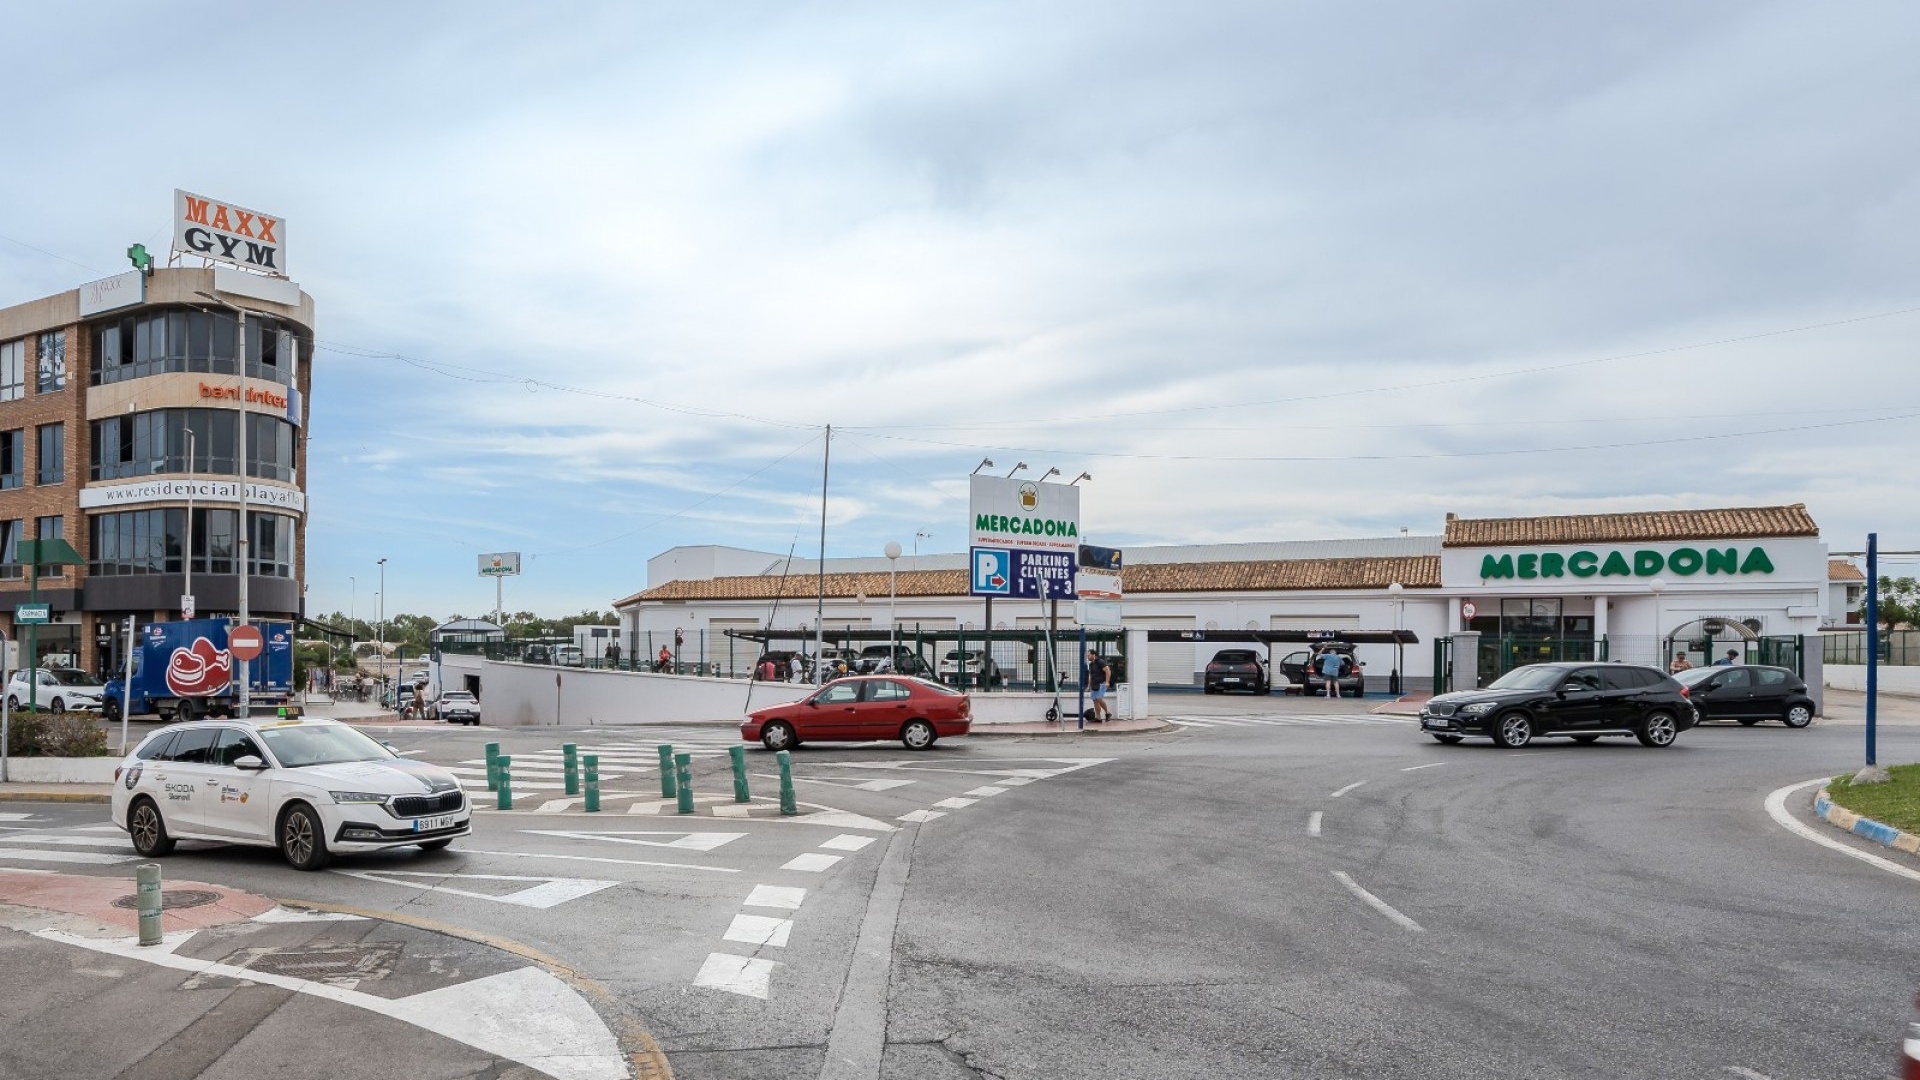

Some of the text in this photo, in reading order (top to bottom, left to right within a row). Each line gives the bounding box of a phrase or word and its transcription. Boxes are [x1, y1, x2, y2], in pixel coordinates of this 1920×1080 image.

[184, 195, 277, 243] MAXX
[184, 227, 277, 269] GYM
[975, 513, 1078, 538] MERCADONA
[978, 554, 998, 586] P
[1021, 553, 1070, 567] PARKING
[1021, 566, 1070, 579] CLIENTES
[1480, 546, 1775, 579] MERCADONA
